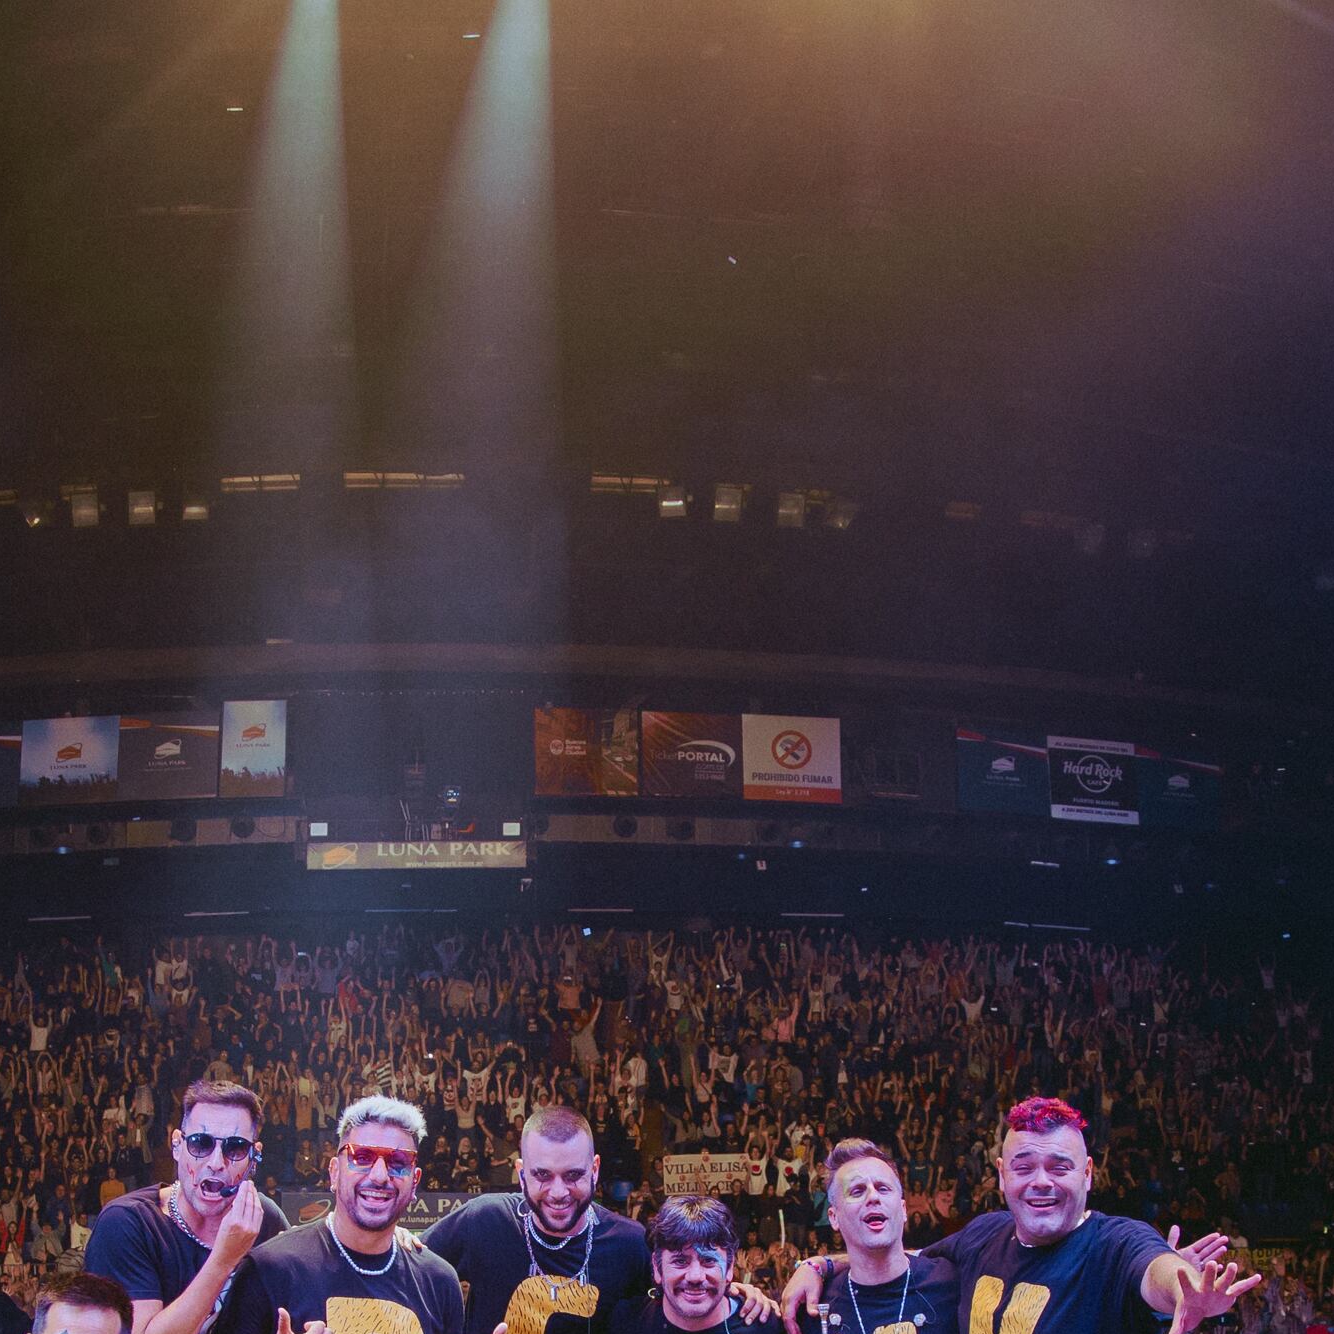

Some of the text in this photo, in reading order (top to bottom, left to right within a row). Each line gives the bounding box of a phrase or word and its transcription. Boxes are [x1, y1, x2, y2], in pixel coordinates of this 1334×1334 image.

[751, 772, 833, 784] PROHIBIDO FUMAR
[1063, 761, 1124, 781] Hard Rock
[377, 842, 511, 857] LUNA PARK
